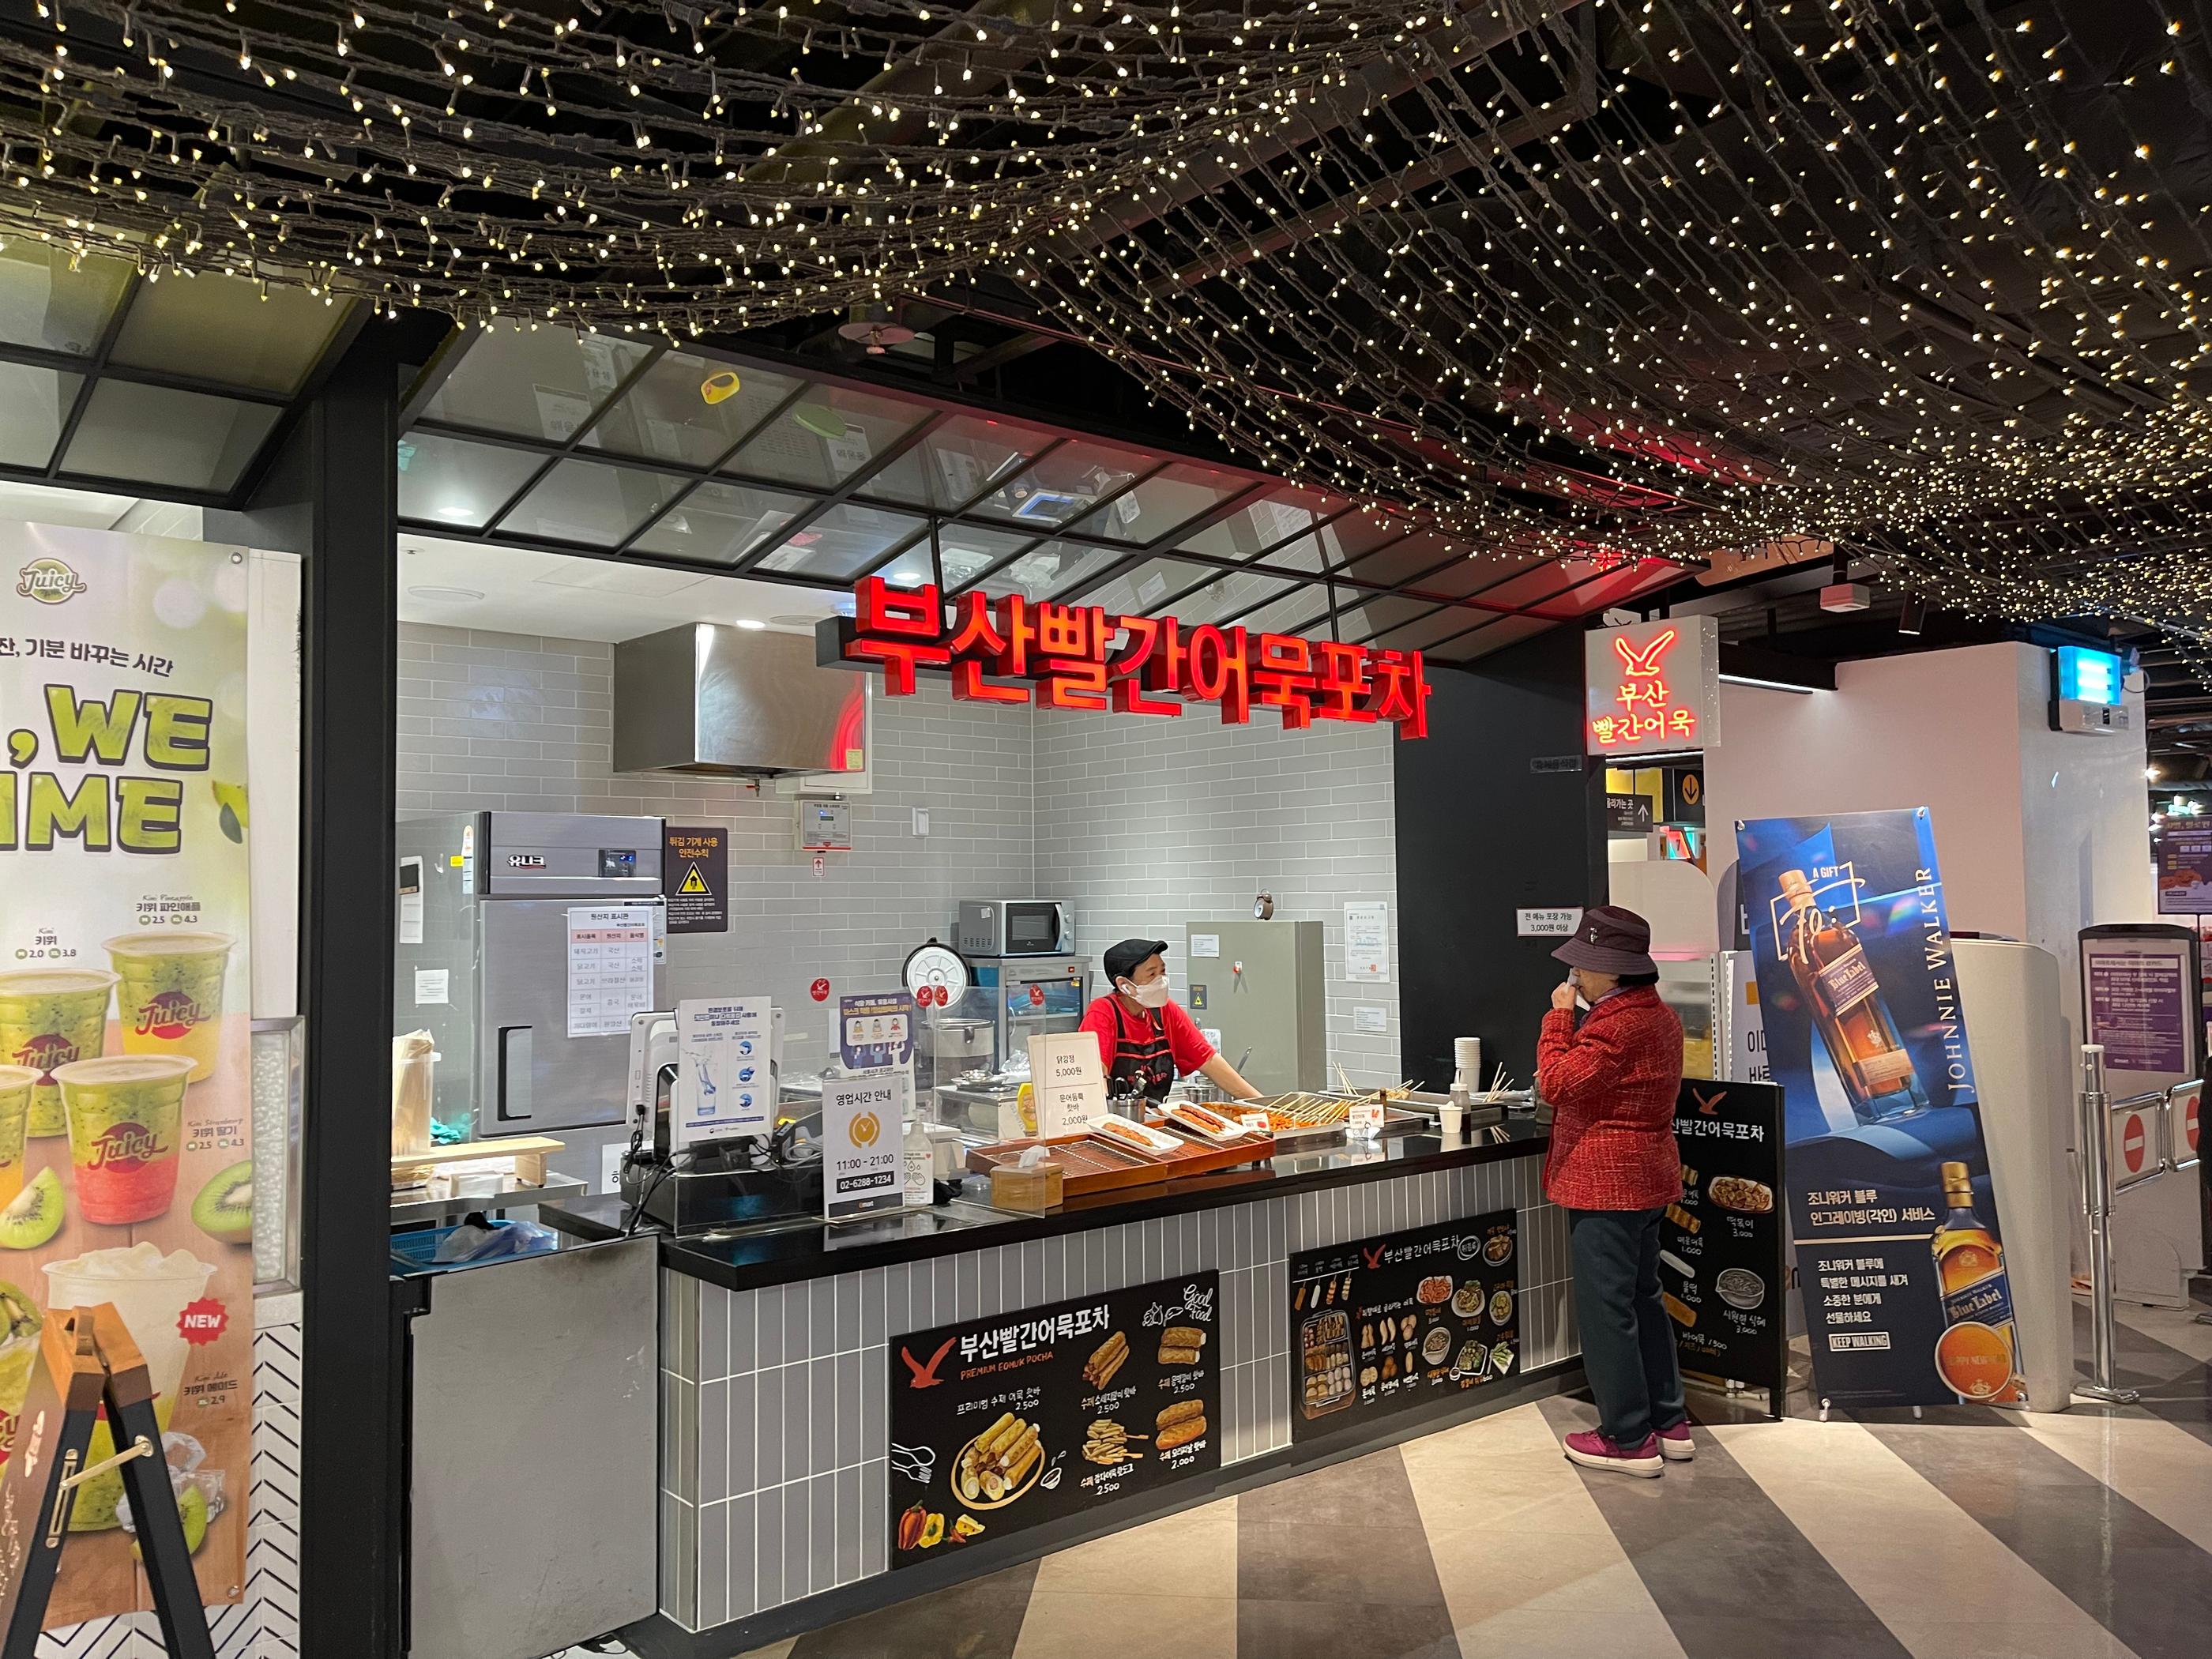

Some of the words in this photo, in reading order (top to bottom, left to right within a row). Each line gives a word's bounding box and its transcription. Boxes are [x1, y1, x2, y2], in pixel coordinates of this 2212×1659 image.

[17, 562, 87, 598] Juicy
[25, 639, 65, 659] 기분
[70, 644, 130, 668] 바꾸는
[133, 653, 174, 677] 시간
[845, 575, 1432, 741] 부산빨간어묵포차
[1616, 679, 1670, 711] 부산
[1592, 709, 1695, 743] 빨간어묵
[669, 837, 685, 847] 튀김
[687, 837, 702, 847] 기계
[703, 837, 718, 848] 사용
[508, 855, 546, 867] 유니크
[679, 848, 709, 858] 안전수칙
[1812, 867, 1819, 878] A
[1820, 866, 1839, 878] GIFT
[136, 902, 157, 912] 키위
[1533, 912, 1545, 921] 메뉴
[1546, 912, 1559, 921] 포장
[1560, 912, 1573, 921] 가능
[1916, 867, 1948, 971] WALKER
[1556, 924, 1568, 932] 이상
[35, 935, 58, 946] 키위
[134, 1000, 212, 1036] Juicy
[1934, 976, 1975, 1093] JOHNNIE
[1055, 1054, 1075, 1064] 닭강정
[1055, 1066, 1082, 1078] 5,000원
[836, 1091, 872, 1106] 영업시간
[874, 1089, 892, 1102] 안내
[1062, 1113, 1089, 1126] 2,000원
[192, 1127, 213, 1138] 키위
[87, 1130, 169, 1171] Juicy
[836, 1158, 862, 1171] 11:00
[870, 1153, 894, 1167] 21:00
[840, 1173, 892, 1190] 02-6288-1234
[1808, 1190, 1852, 1206] 조니워커
[1854, 1189, 1878, 1204] 블루
[1810, 1208, 1898, 1226] 인그레이빙(각인)
[1902, 1206, 1936, 1222] 서비스
[1383, 1234, 1461, 1264] 부산빨간어묵포차
[1818, 1258, 1854, 1272] 조니워커
[1856, 1258, 1884, 1270] 블루에
[1820, 1276, 1849, 1288] 특별한
[1849, 1274, 1887, 1288] 메시지를
[1890, 1273, 1909, 1286] 새겨
[1823, 1294, 1852, 1307] 소중한
[1853, 1292, 1882, 1306] 분에게
[183, 1313, 222, 1330] NEW
[1825, 1311, 1872, 1325] 선물하세요
[960, 1304, 1110, 1363] 부산빨간어묵포차
[1830, 1337, 1851, 1349] KEEP
[1851, 1334, 1887, 1348] WALKING
[960, 1364, 996, 1380] PREMIUM
[998, 1357, 1025, 1372] EOMUK
[1026, 1351, 1054, 1364] POCHA
[957, 1399, 988, 1415] 프리미엄
[991, 1394, 1006, 1407] 수제
[1009, 1390, 1024, 1402] 어묵
[1015, 1399, 1040, 1411] 2.500
